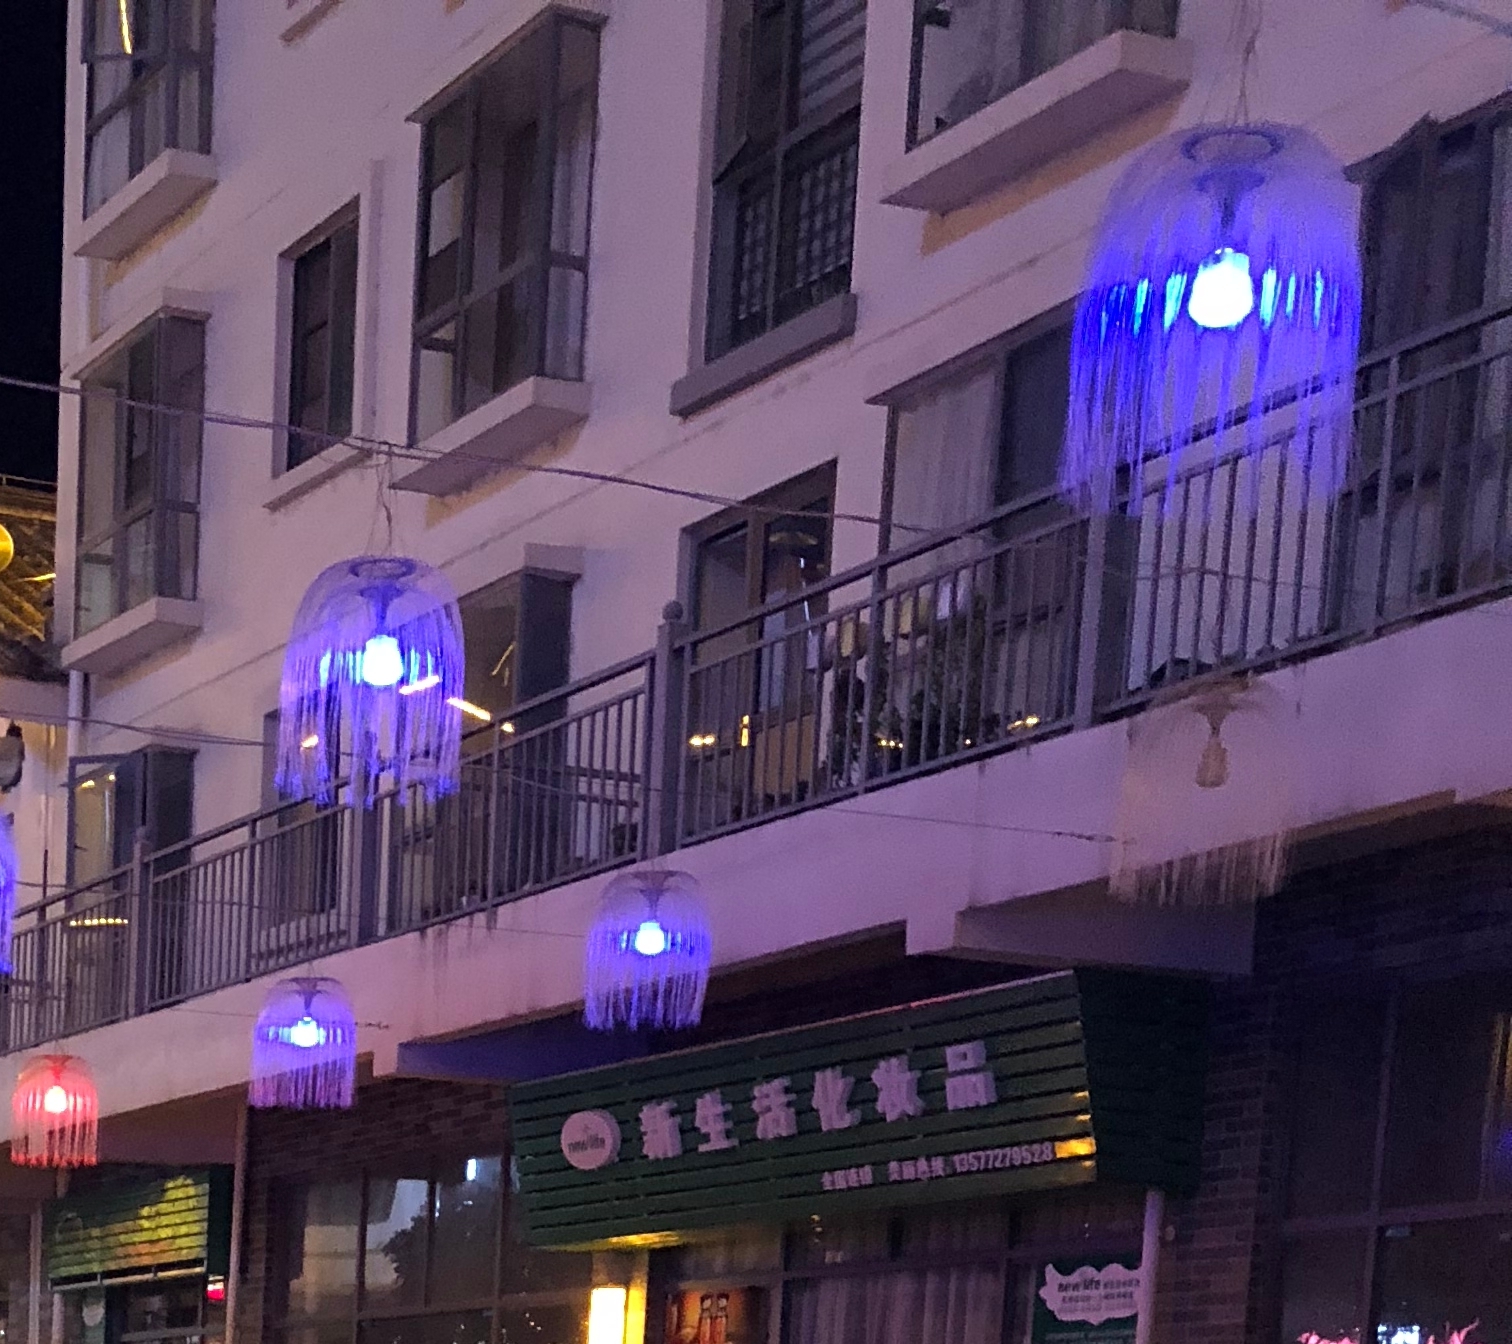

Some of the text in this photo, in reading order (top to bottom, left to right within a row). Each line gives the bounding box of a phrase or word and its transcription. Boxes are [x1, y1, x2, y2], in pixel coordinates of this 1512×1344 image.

[639, 1040, 997, 1160] 新生活化妆品
